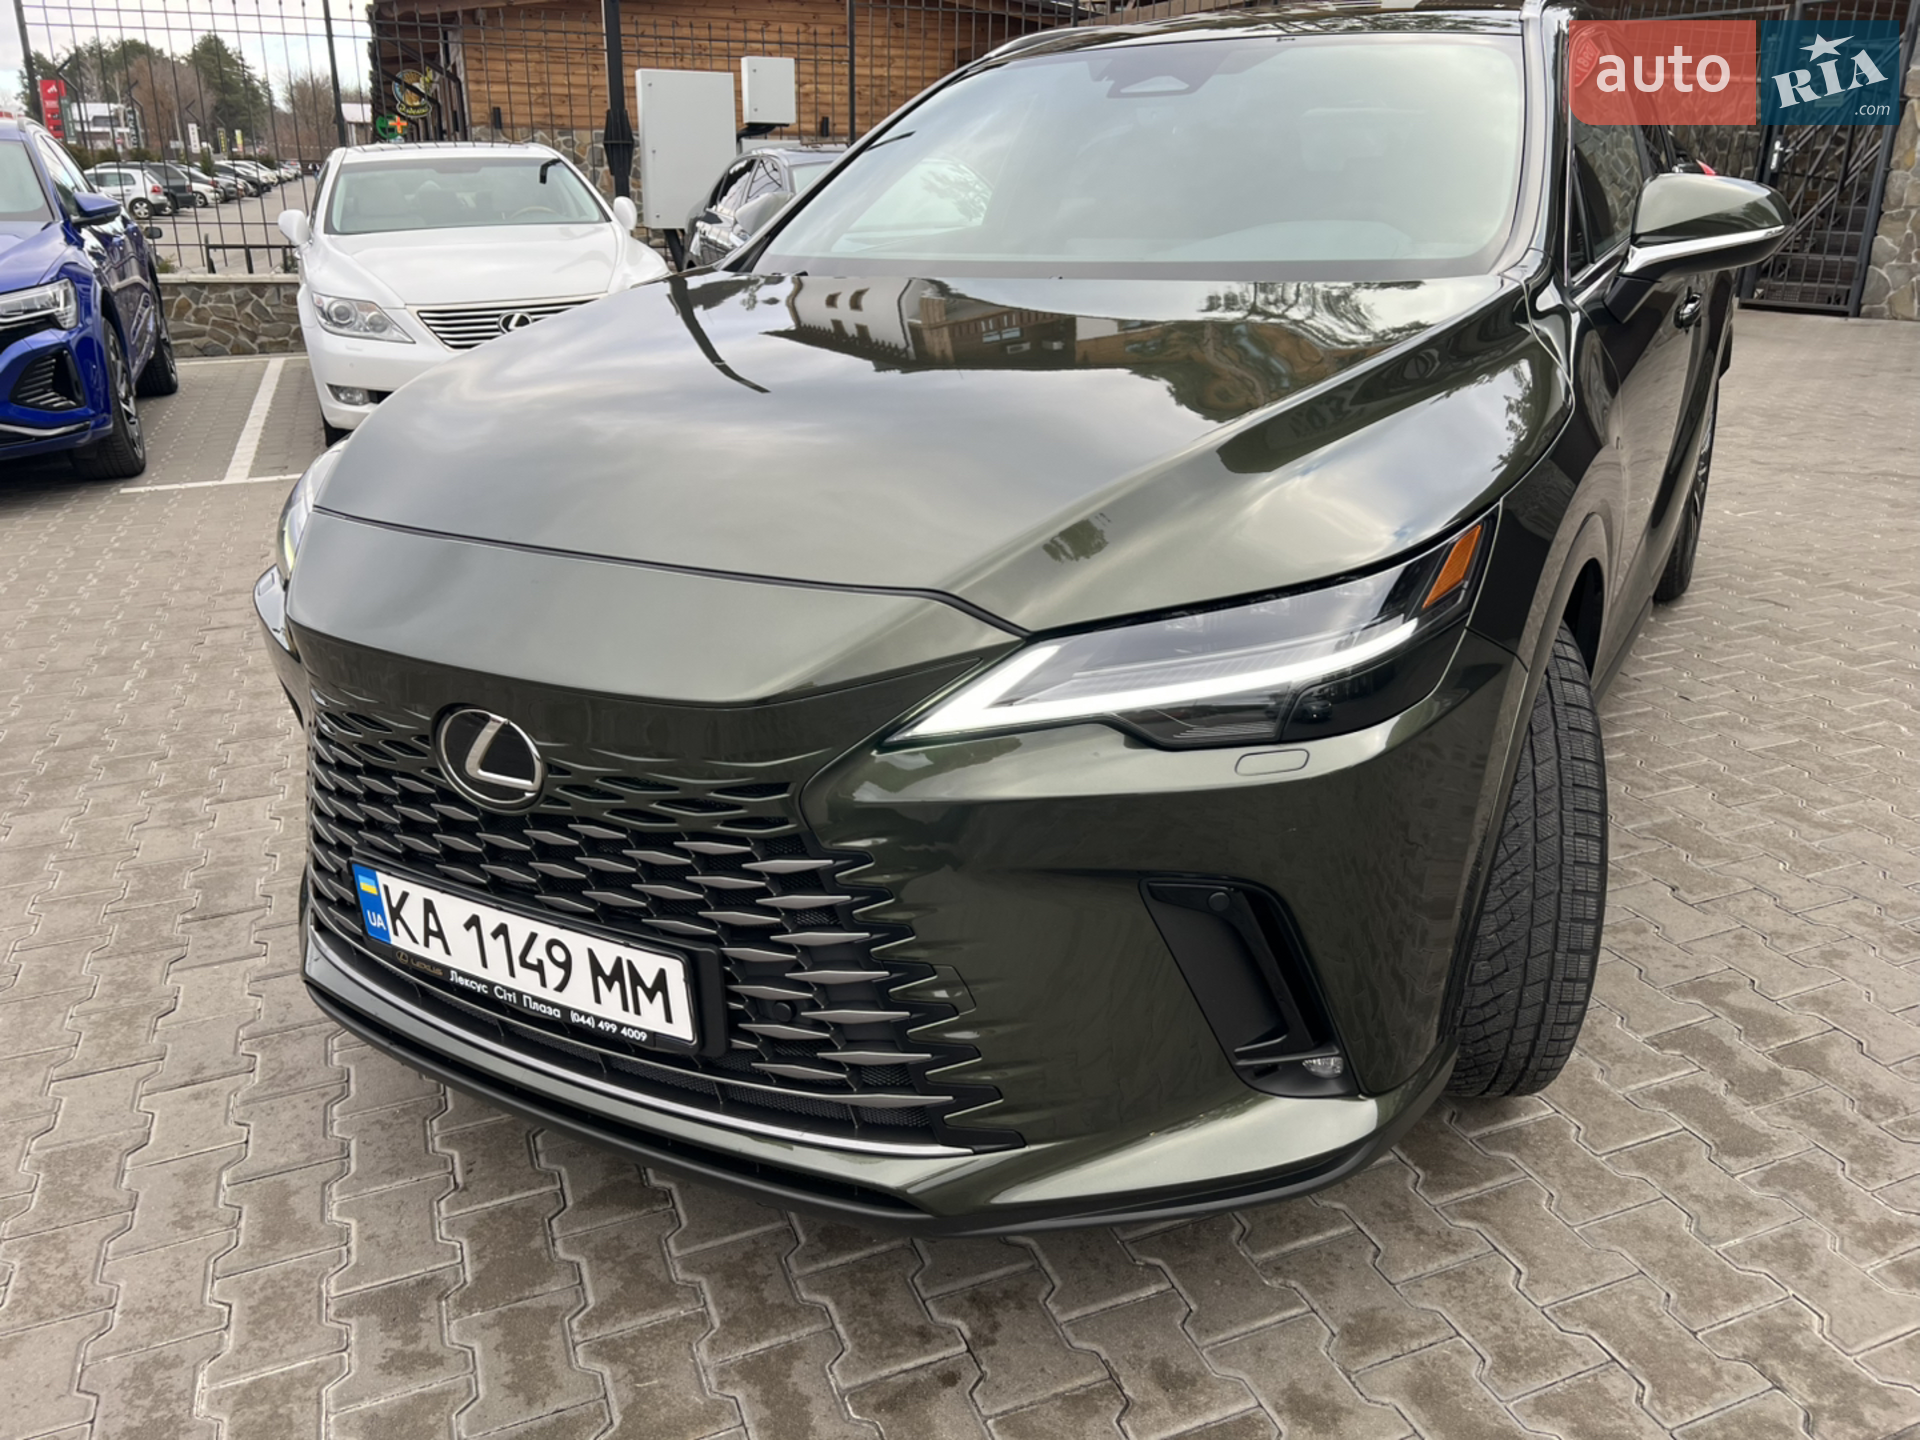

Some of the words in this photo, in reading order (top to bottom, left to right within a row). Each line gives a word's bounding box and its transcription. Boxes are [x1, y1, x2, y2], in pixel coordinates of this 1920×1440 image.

[367, 909, 387, 931] UA
[383, 883, 452, 957] KA
[463, 913, 573, 993] 1149
[587, 947, 673, 1025] MM
[410, 957, 443, 976] LEXUS
[449, 970, 489, 994] Лексус
[493, 985, 517, 1004] Сіті
[522, 994, 562, 1019] Плаза
[570, 1010, 596, 1029] (044)
[597, 1020, 618, 1034] 499
[620, 1027, 648, 1042] 4009
